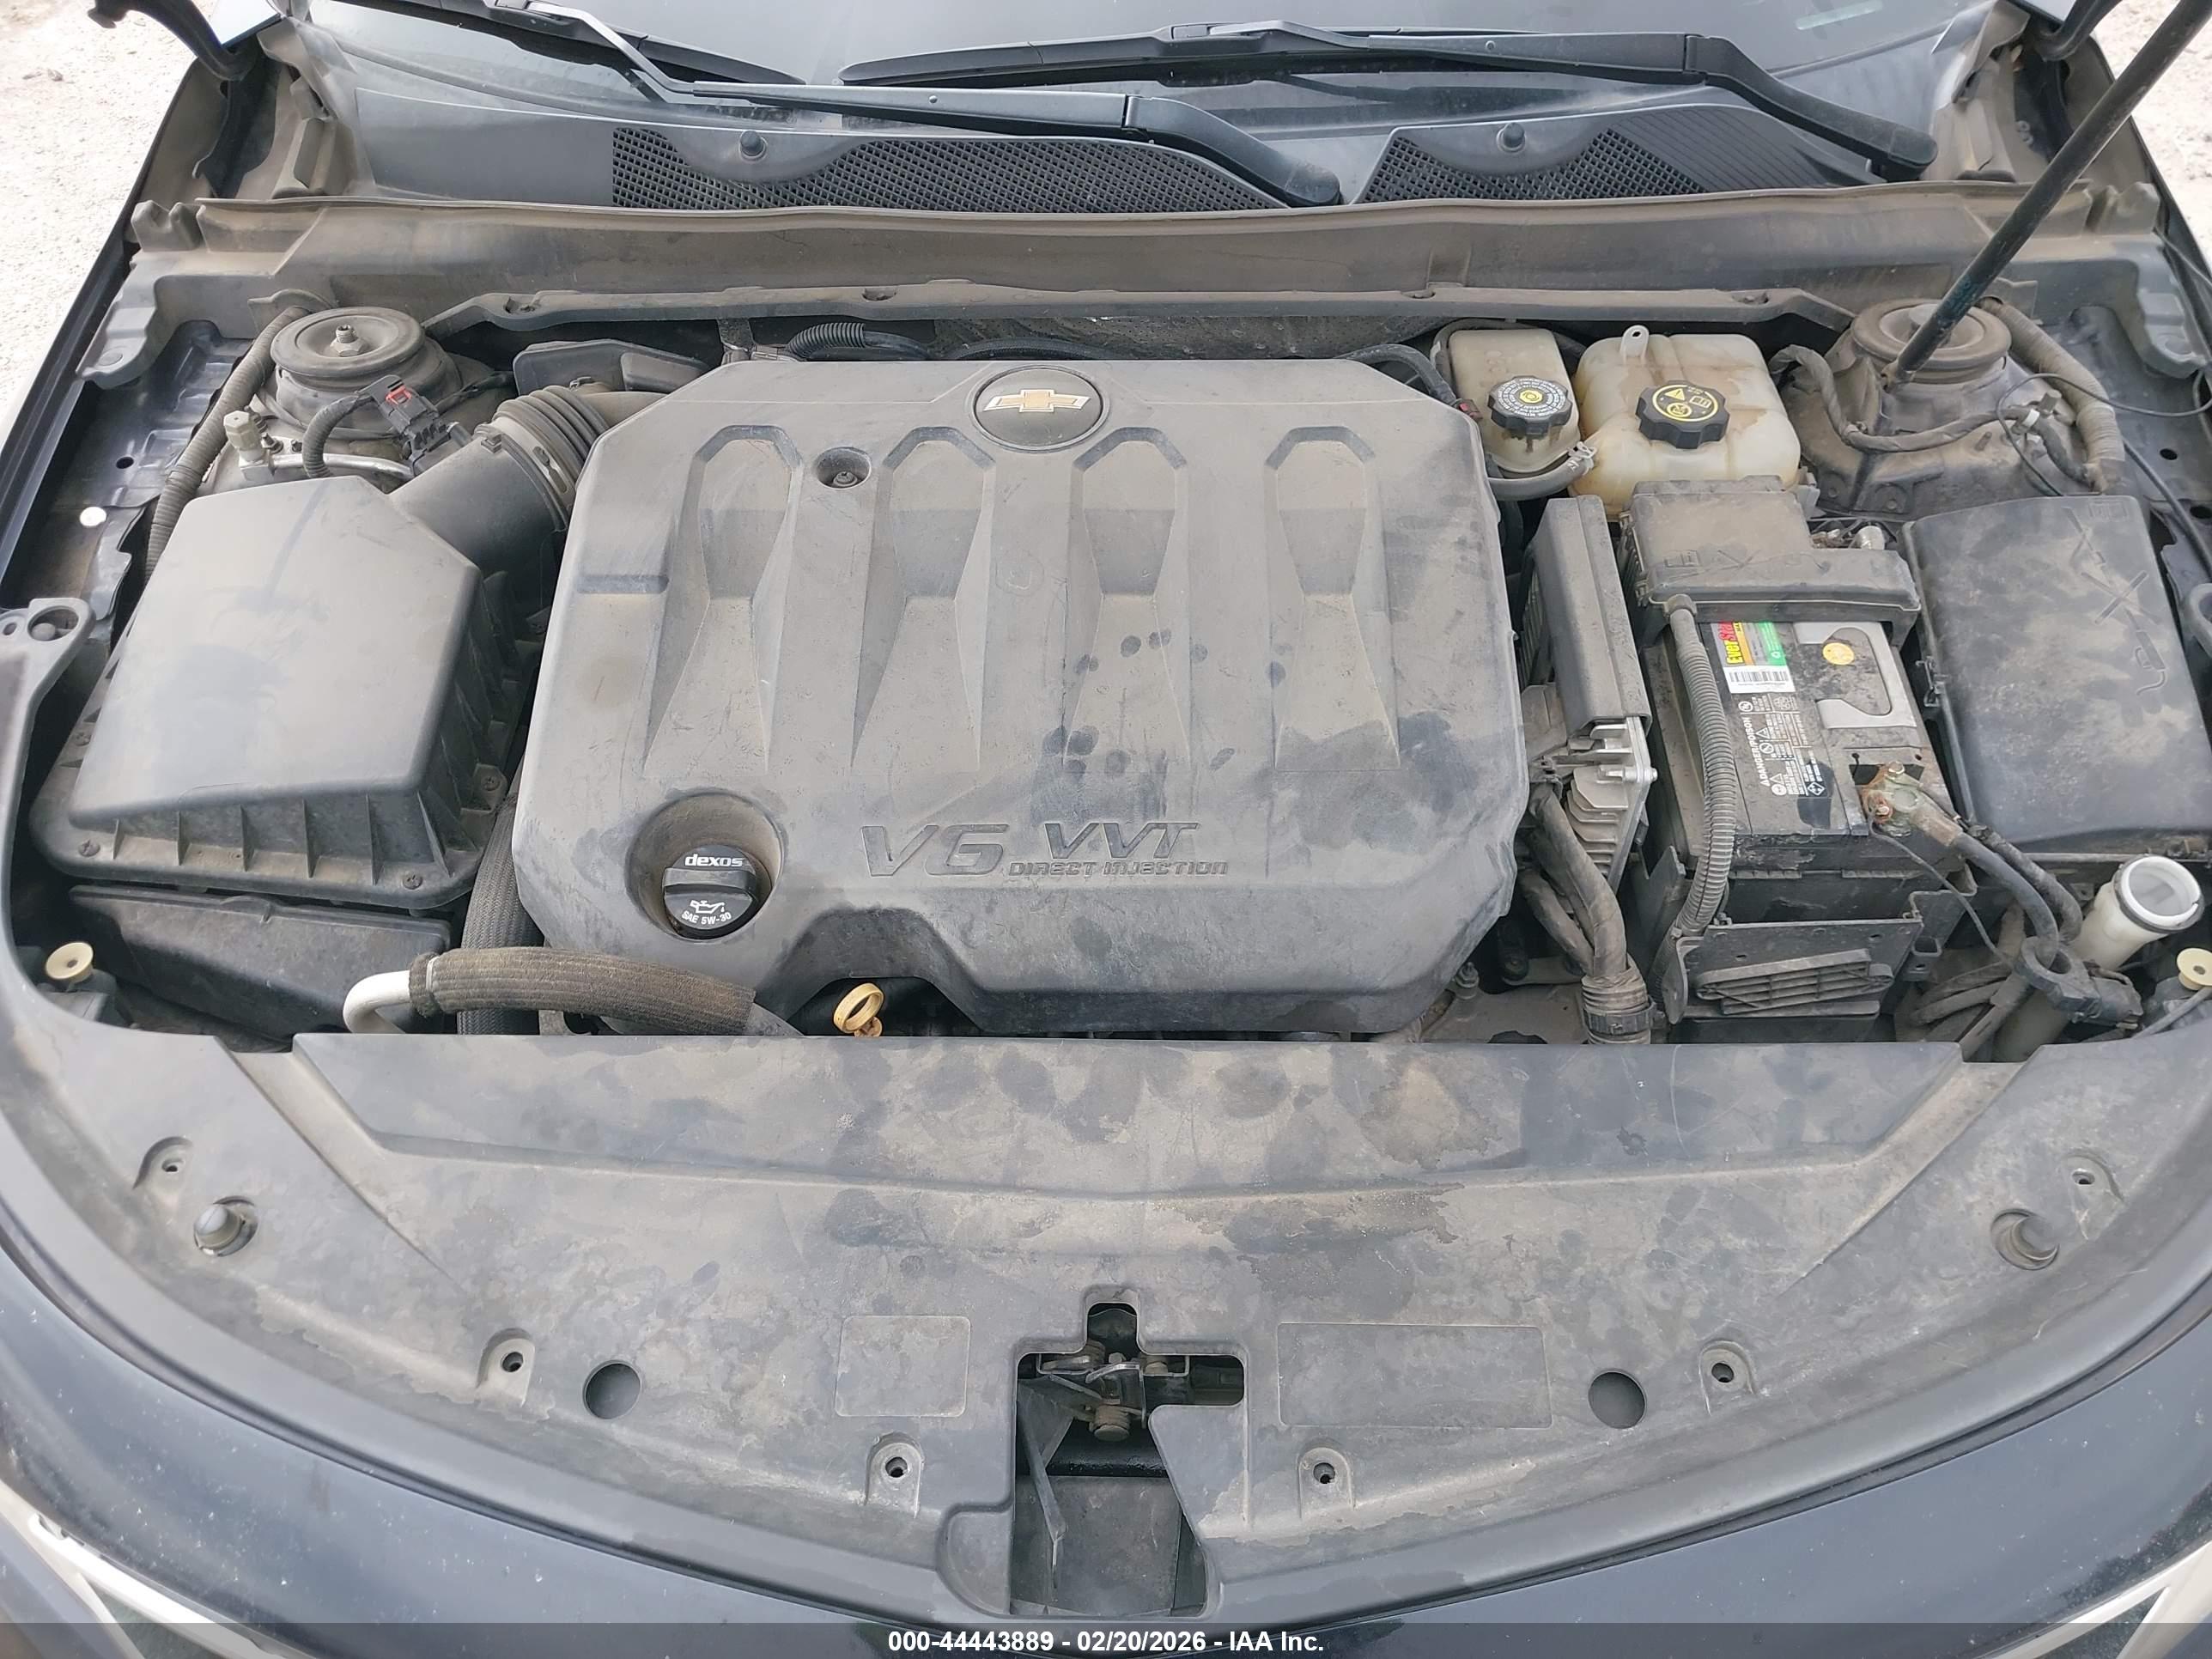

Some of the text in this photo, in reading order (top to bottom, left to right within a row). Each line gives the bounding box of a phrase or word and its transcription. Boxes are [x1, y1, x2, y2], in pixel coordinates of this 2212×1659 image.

[1717, 622, 1744, 665] EverSta
[1742, 716, 1770, 780] DANGER/POISON
[684, 854, 745, 867] dexos
[860, 822, 1200, 877] V6 VVT
[1008, 860, 1229, 876] DIRECT INJECTION
[681, 910, 732, 926] SAE 5W-30
